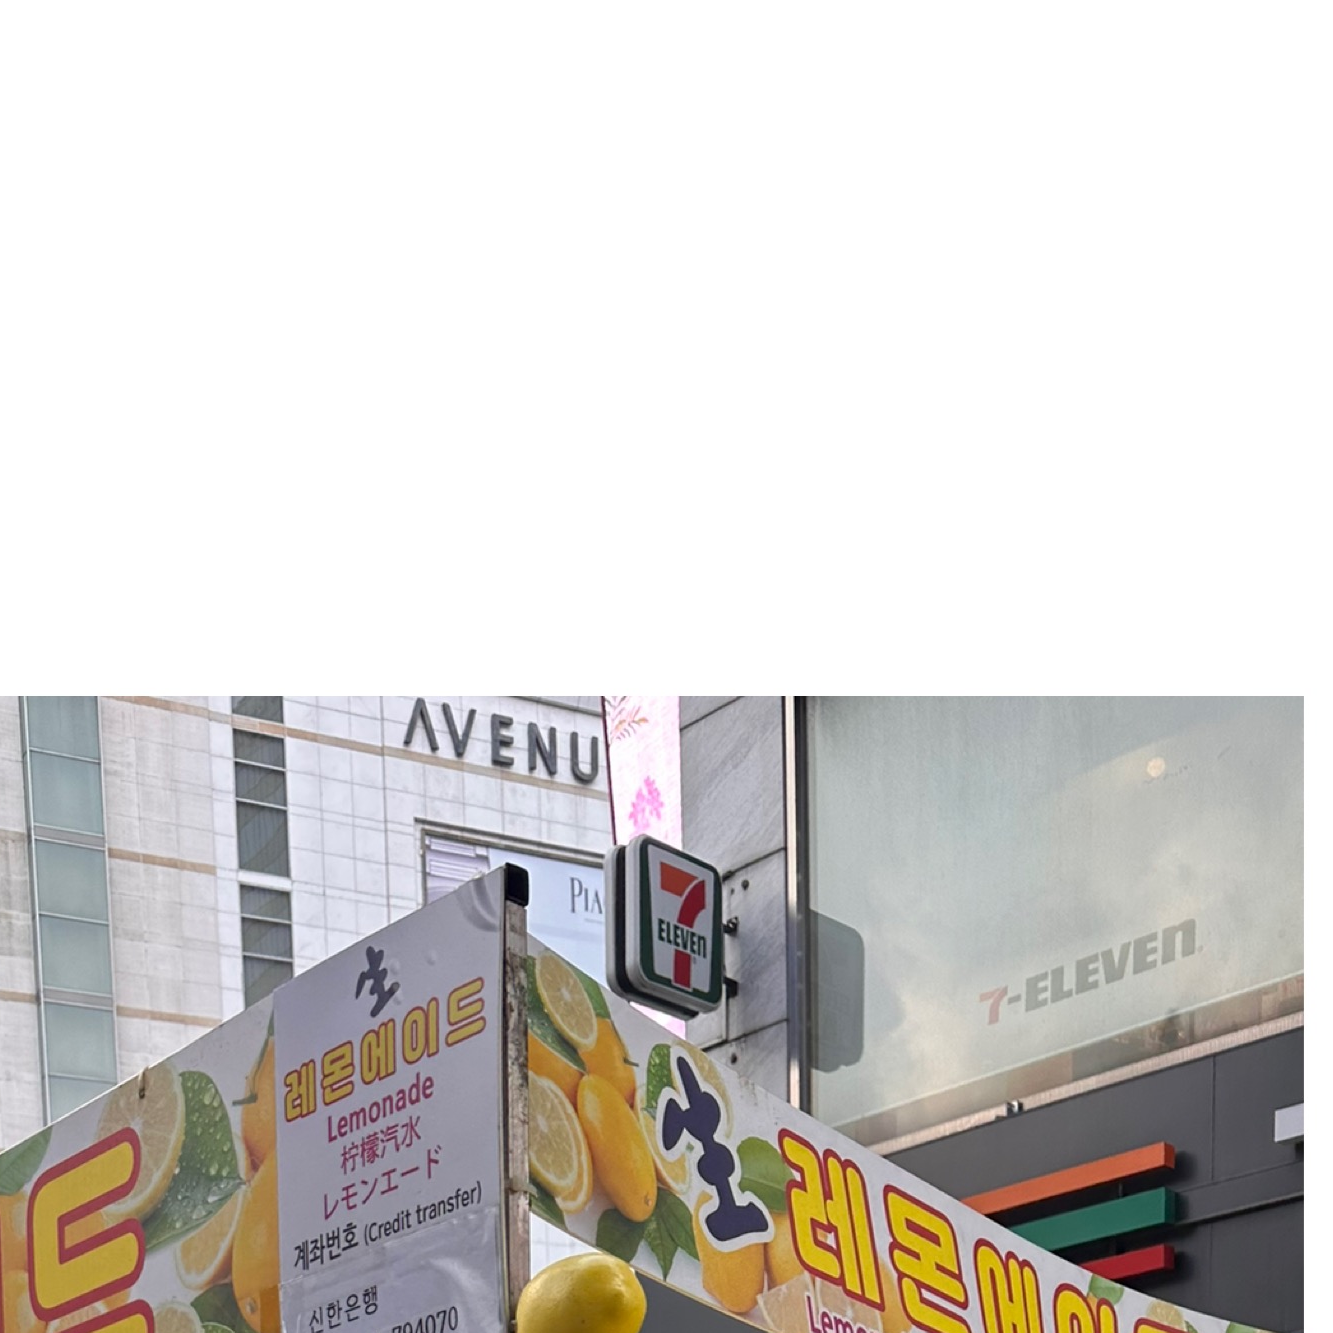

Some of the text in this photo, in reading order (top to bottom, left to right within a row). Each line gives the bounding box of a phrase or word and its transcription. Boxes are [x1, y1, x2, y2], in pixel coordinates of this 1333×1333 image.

[283, 977, 488, 1123] 레몬에이드
[327, 1072, 436, 1144] Lemonade
[322, 1145, 443, 1222] レモンエード
[340, 1117, 422, 1177] 柠檬汽水
[293, 1180, 483, 1271] 계좌번호 (Credit transfer)
